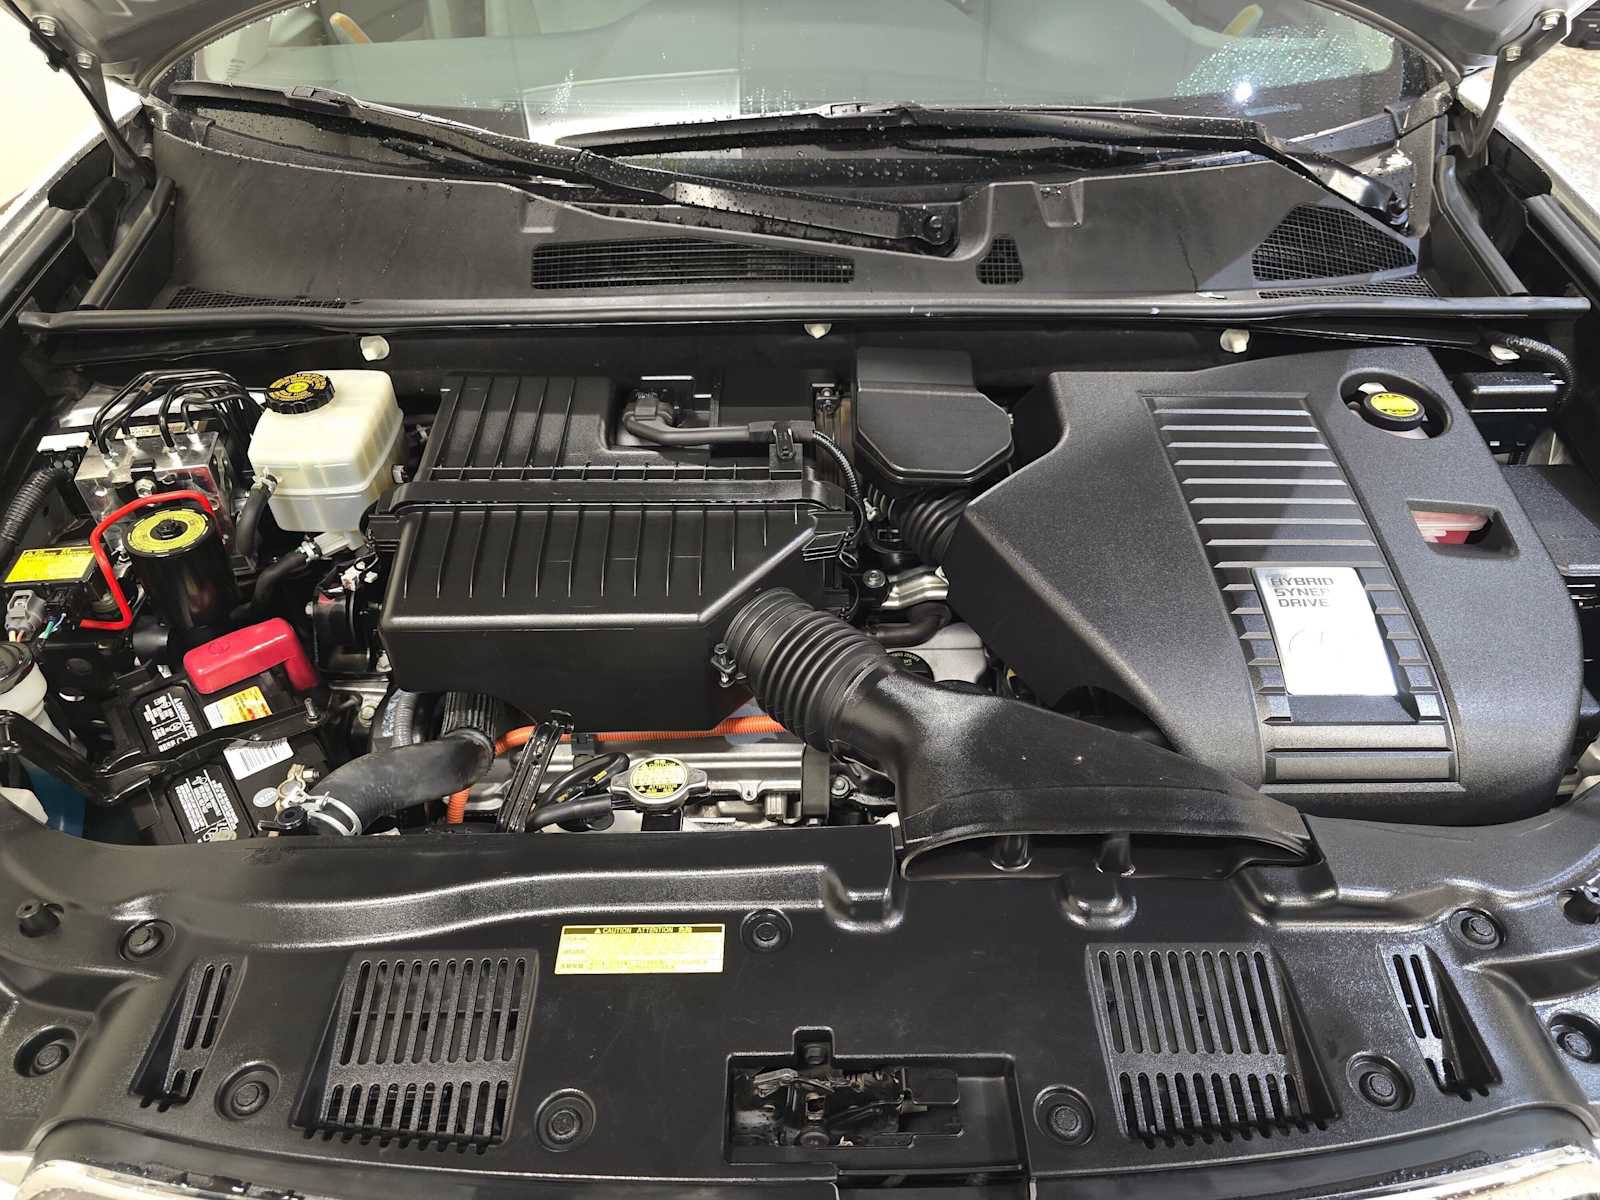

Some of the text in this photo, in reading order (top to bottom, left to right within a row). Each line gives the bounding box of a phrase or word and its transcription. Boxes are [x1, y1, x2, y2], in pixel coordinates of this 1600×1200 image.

[1270, 577, 1335, 586] HYBRID
[1278, 598, 1330, 608] DRIVE
[636, 926, 674, 934] ATTENTION
